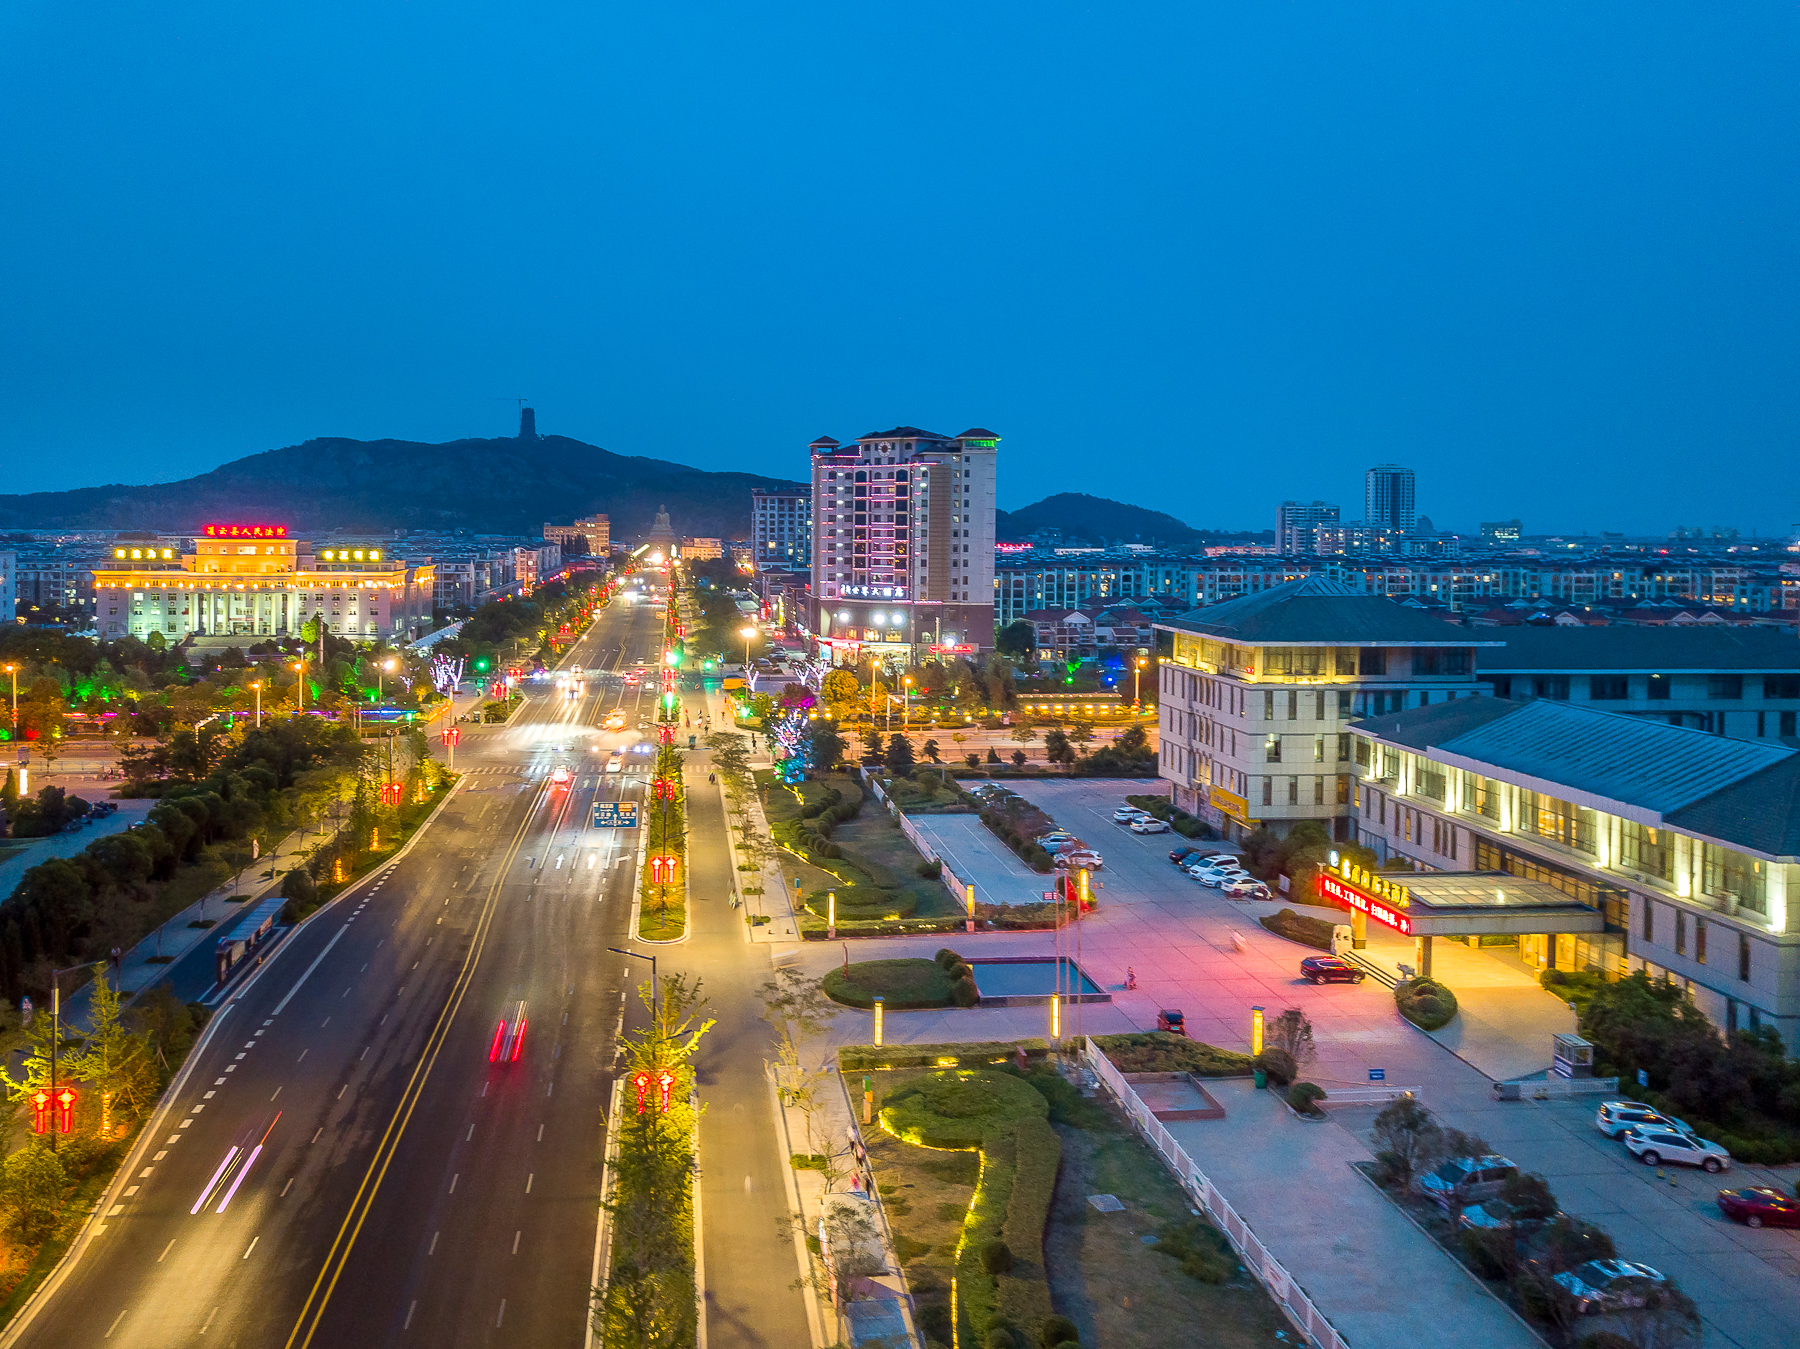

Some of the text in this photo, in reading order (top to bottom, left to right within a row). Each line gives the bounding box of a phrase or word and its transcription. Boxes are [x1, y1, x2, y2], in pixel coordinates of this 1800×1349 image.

[206, 525, 285, 537] 灌云县人民法院
